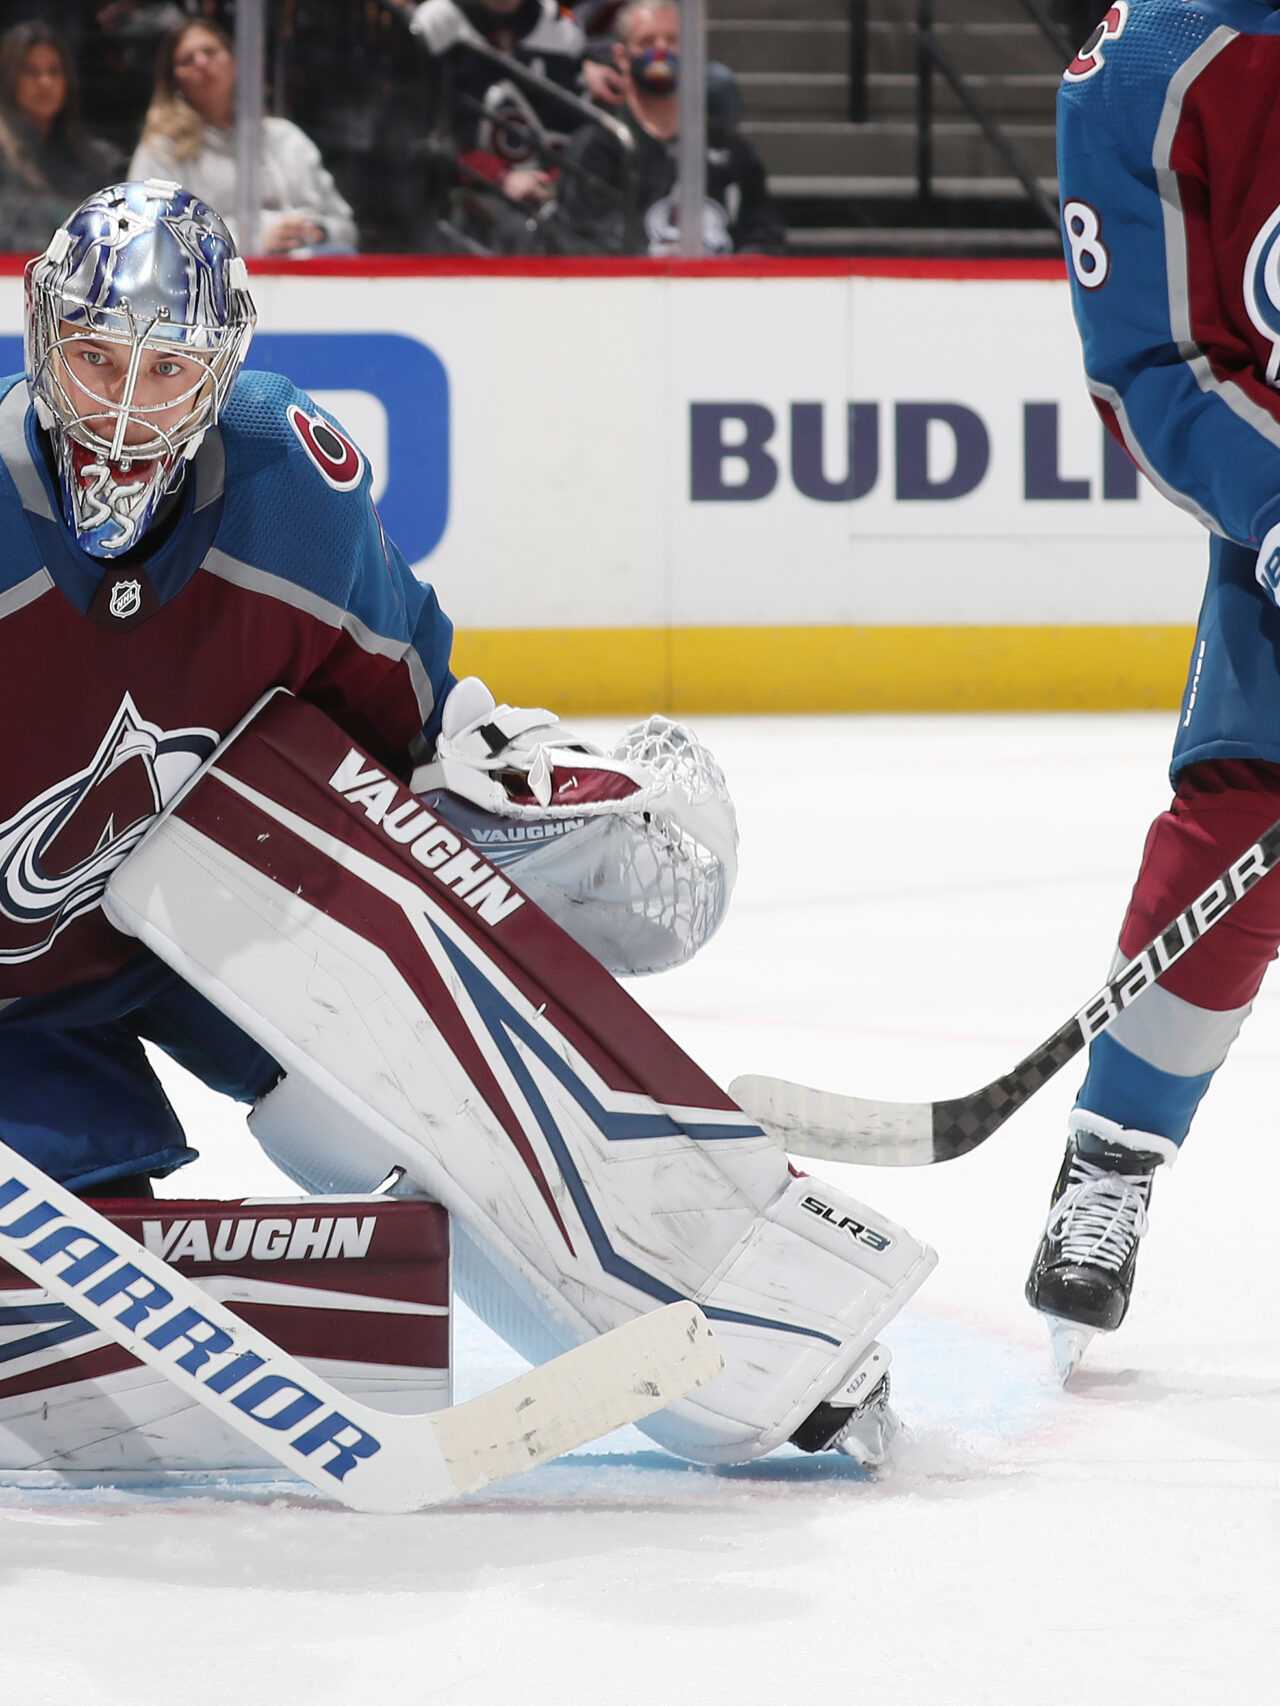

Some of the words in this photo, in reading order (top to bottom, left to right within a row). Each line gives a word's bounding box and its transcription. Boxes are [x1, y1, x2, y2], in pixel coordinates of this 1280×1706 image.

[1063, 198, 1111, 291] 8
[688, 401, 990, 501] BUD
[78, 464, 145, 548] 35
[328, 747, 526, 927] VAUGHN
[470, 819, 585, 842] VAUGHN
[141, 1216, 377, 1263] VAUGHN
[800, 1196, 892, 1252] SLR3
